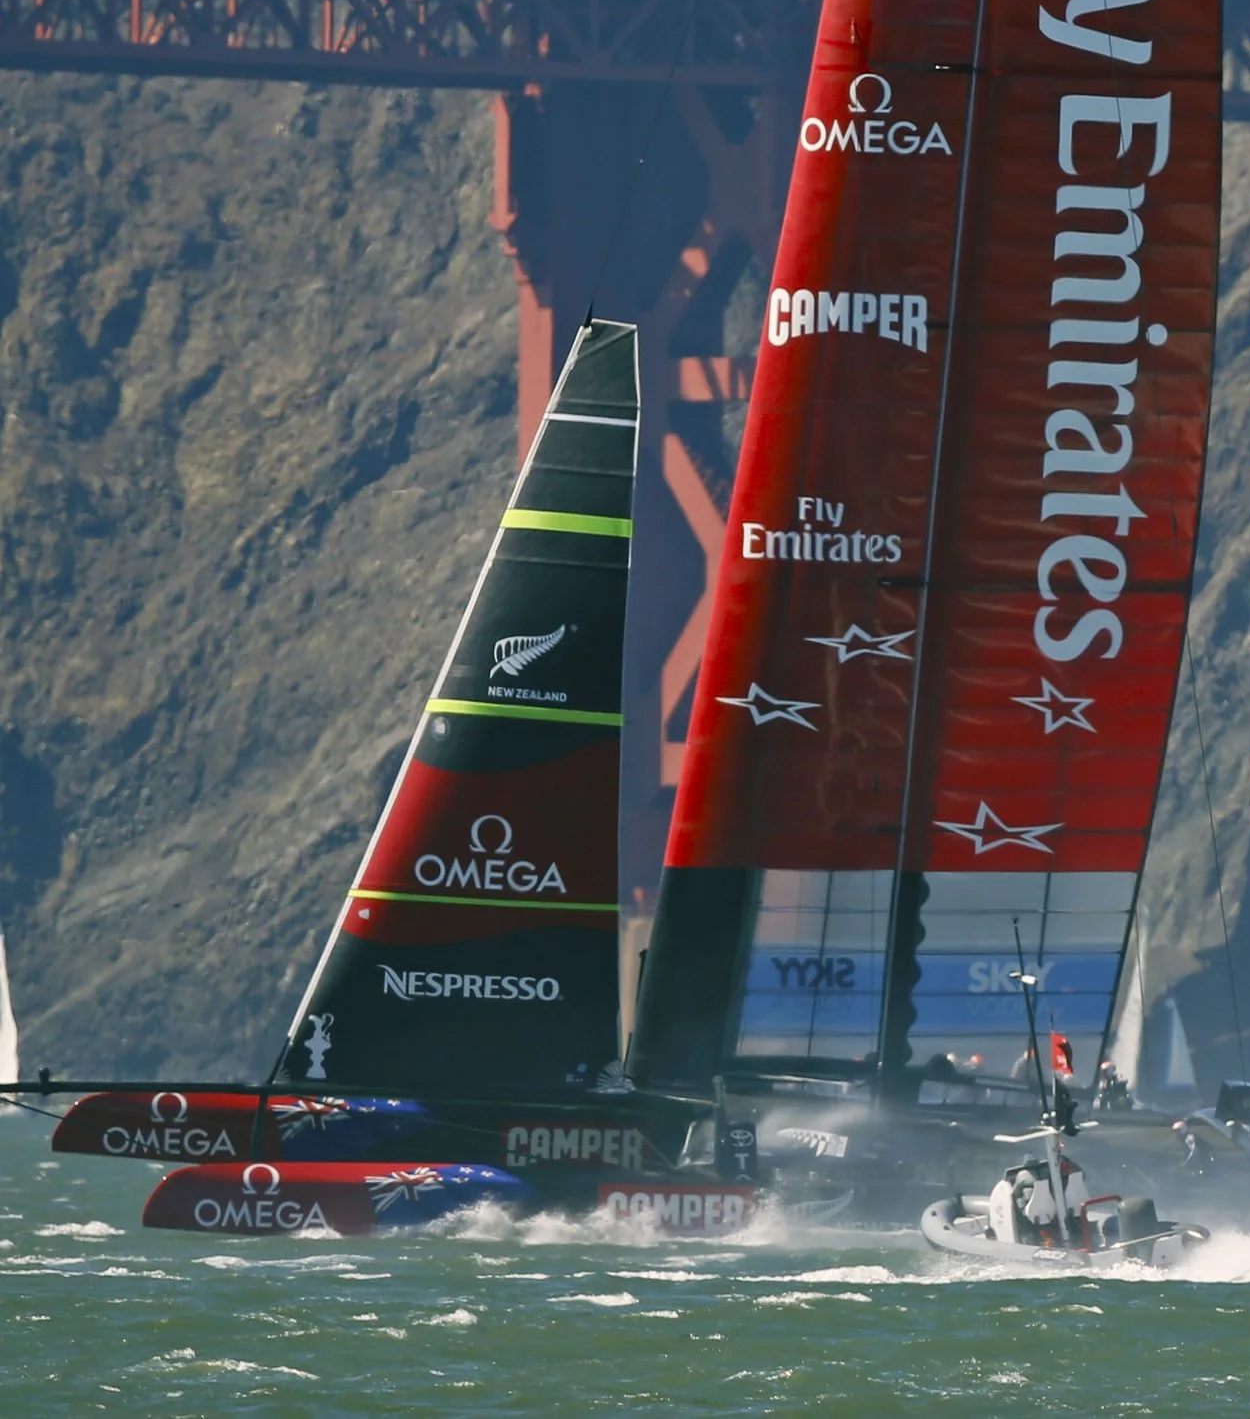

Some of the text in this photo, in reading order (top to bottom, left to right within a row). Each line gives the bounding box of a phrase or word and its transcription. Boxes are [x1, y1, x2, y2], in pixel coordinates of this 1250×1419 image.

[800, 117, 953, 155] OMEGA
[767, 287, 928, 353] CAMPER
[1032, 91, 1172, 662] Emirates
[797, 497, 844, 527] Fly
[742, 522, 902, 563] Emirates
[488, 686, 568, 702] NEW ZEALAND
[414, 854, 568, 894] OMEGA
[376, 964, 561, 1001] NESPRESSO
[103, 1126, 236, 1157] OMEGA
[506, 1126, 643, 1171] CAMPER
[195, 1199, 330, 1230] OMEGA
